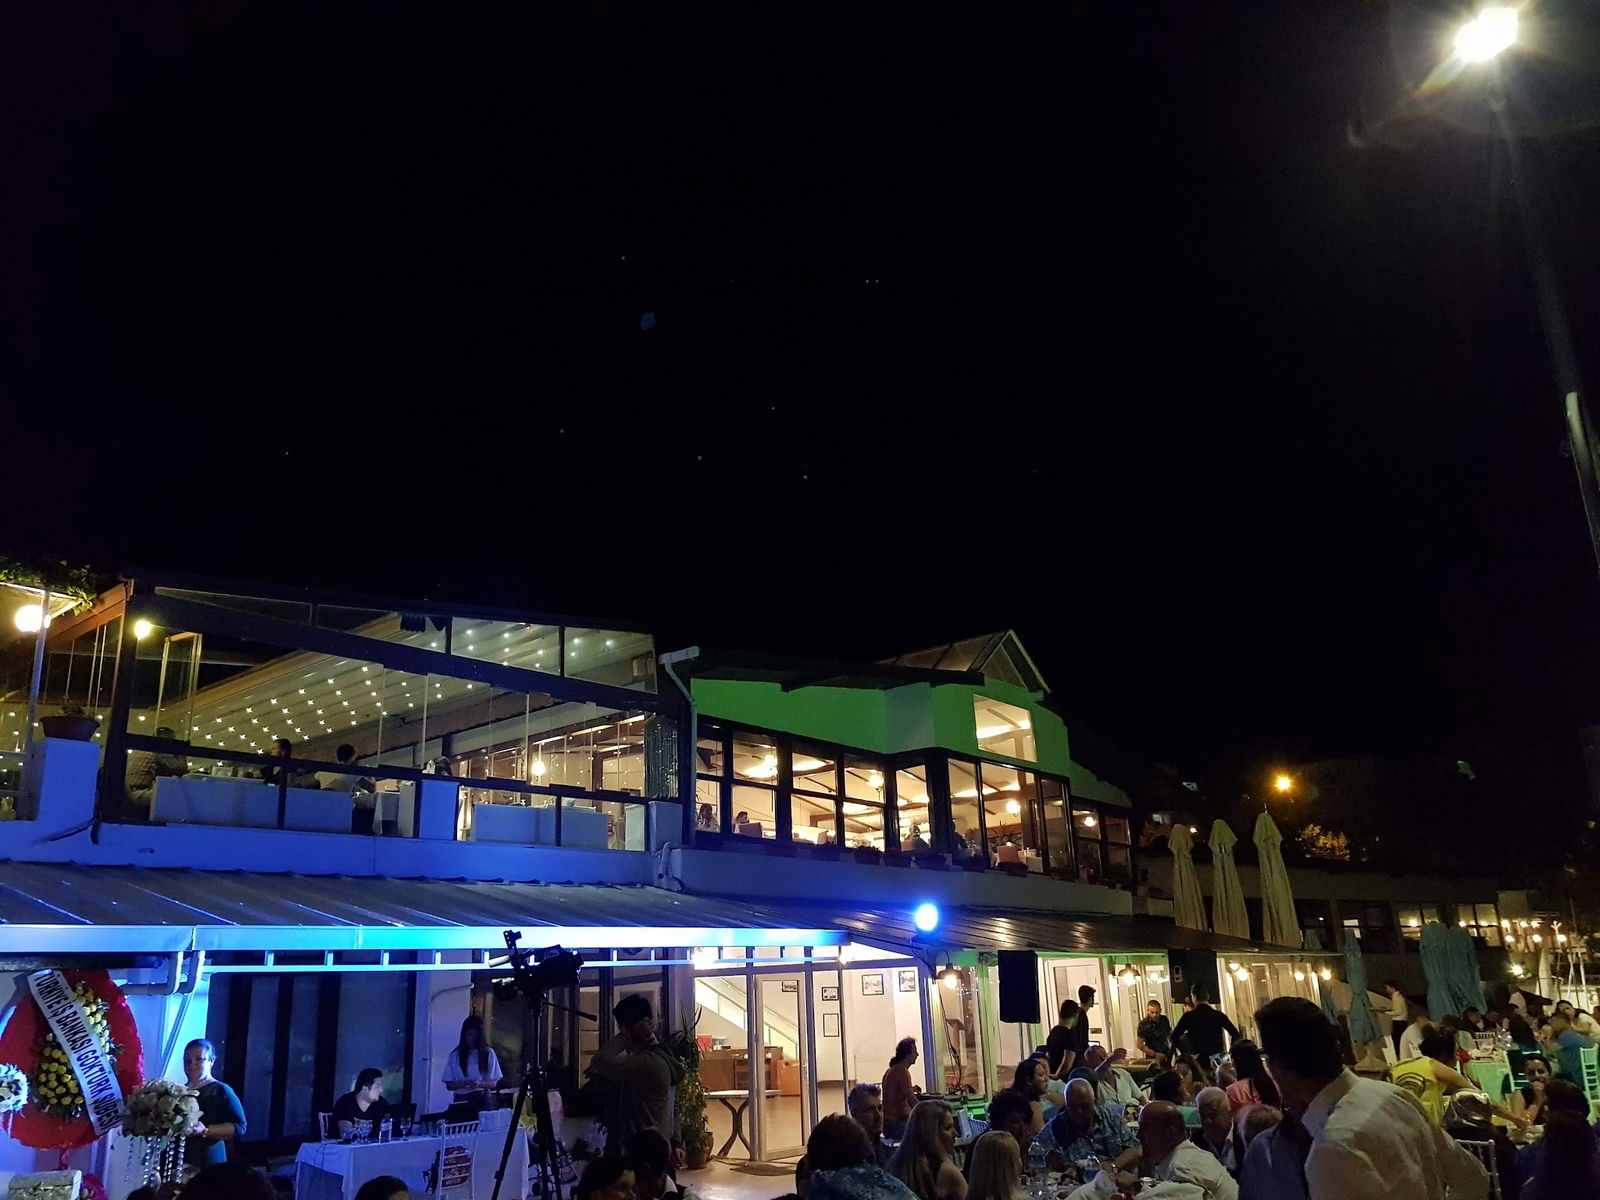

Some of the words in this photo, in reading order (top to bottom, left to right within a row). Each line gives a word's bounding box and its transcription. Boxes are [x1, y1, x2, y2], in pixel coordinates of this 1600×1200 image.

[48, 999, 77, 1020] İŞ
[56, 1010, 93, 1054] BANKASI
[76, 1049, 112, 1099] GÖKTÜRK
